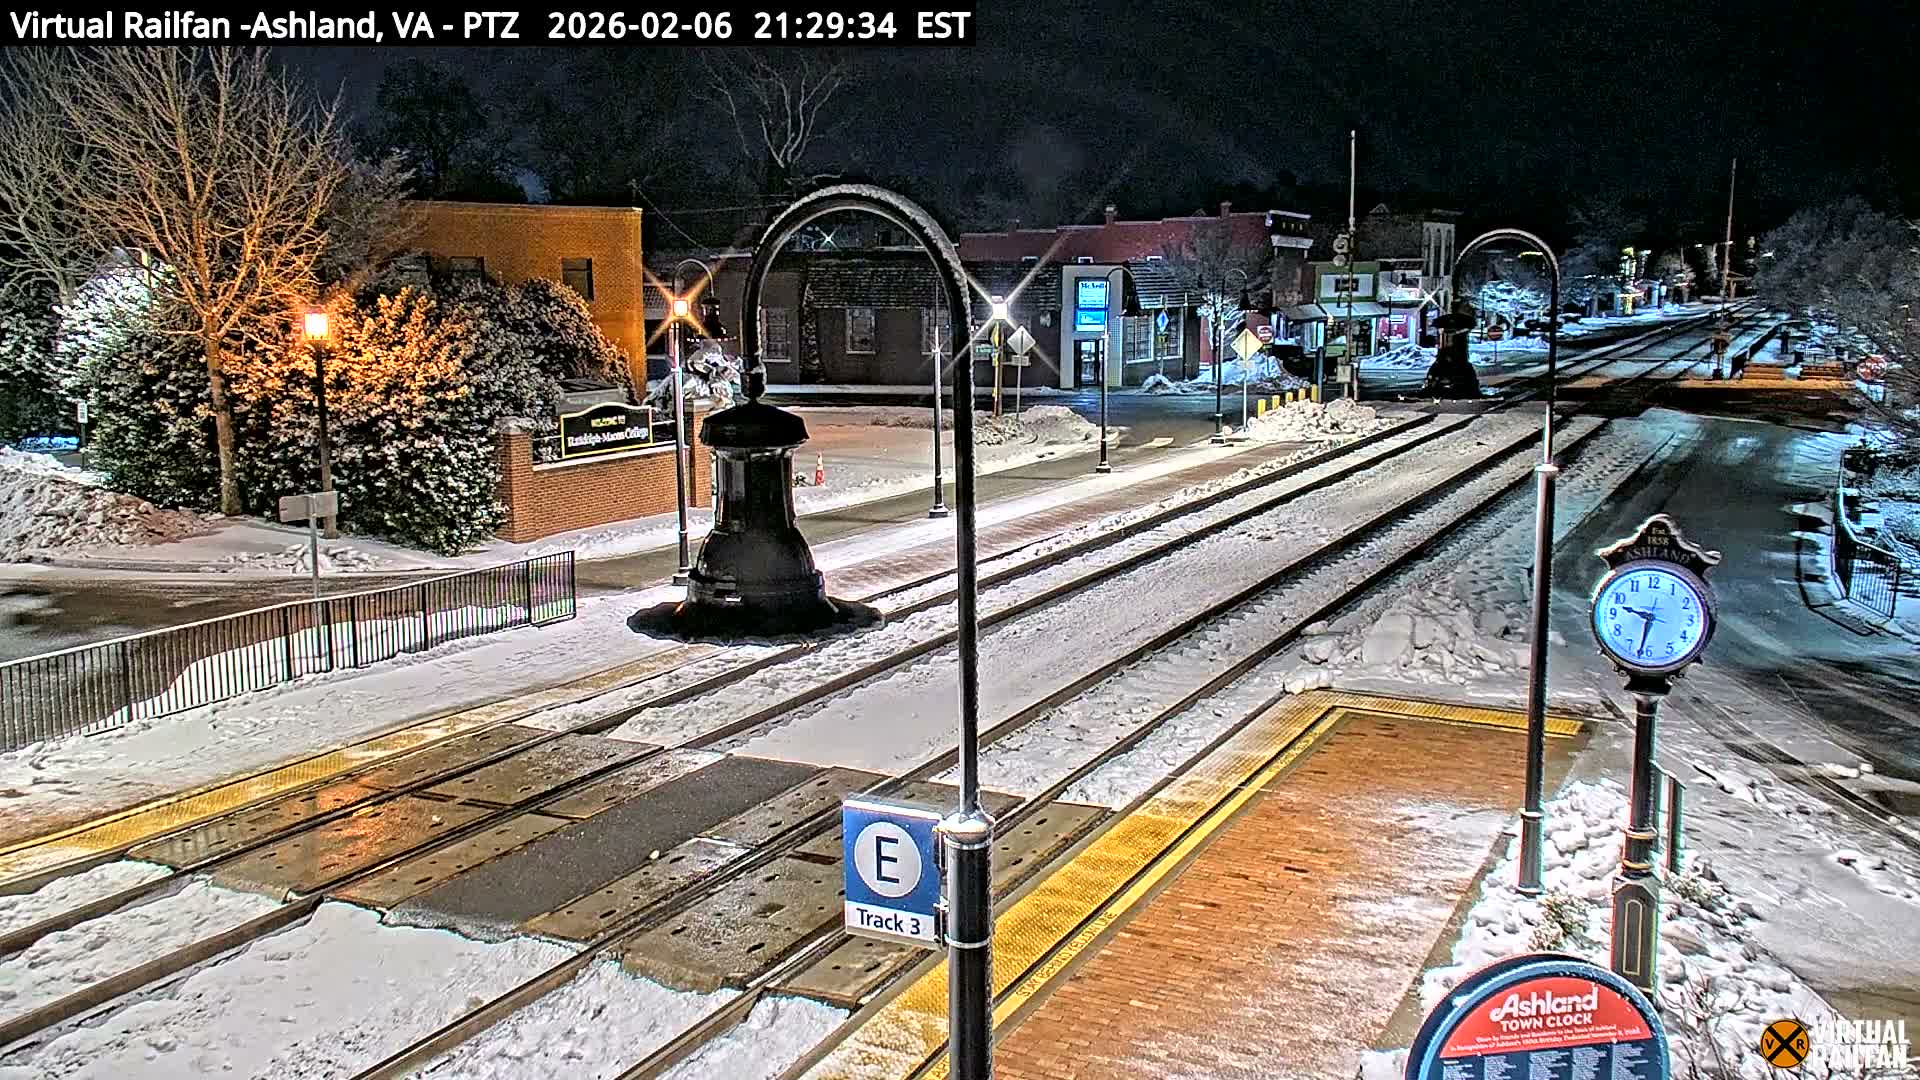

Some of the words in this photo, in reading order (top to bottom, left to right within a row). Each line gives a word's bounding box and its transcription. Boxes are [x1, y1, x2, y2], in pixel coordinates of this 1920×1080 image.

[1630, 580, 1640, 593] 11
[1648, 576, 1661, 589] 12
[1670, 583, 1676, 596] 1
[1614, 592, 1627, 605] 10
[1682, 596, 1690, 610] 2
[1609, 607, 1617, 620] 9
[1687, 614, 1695, 627] 3
[1613, 623, 1623, 637] 8
[1679, 630, 1688, 643] 4
[1626, 638, 1634, 651] 7
[1645, 644, 1653, 657] 6
[1665, 642, 1674, 655] 5
[875, 835, 900, 884] E
[856, 907, 904, 933] Track
[910, 917, 921, 936] 3
[1489, 986, 1599, 1022] Ashland
[1500, 1017, 1543, 1032] TOWN
[1546, 1012, 1593, 1028] CLOCK
